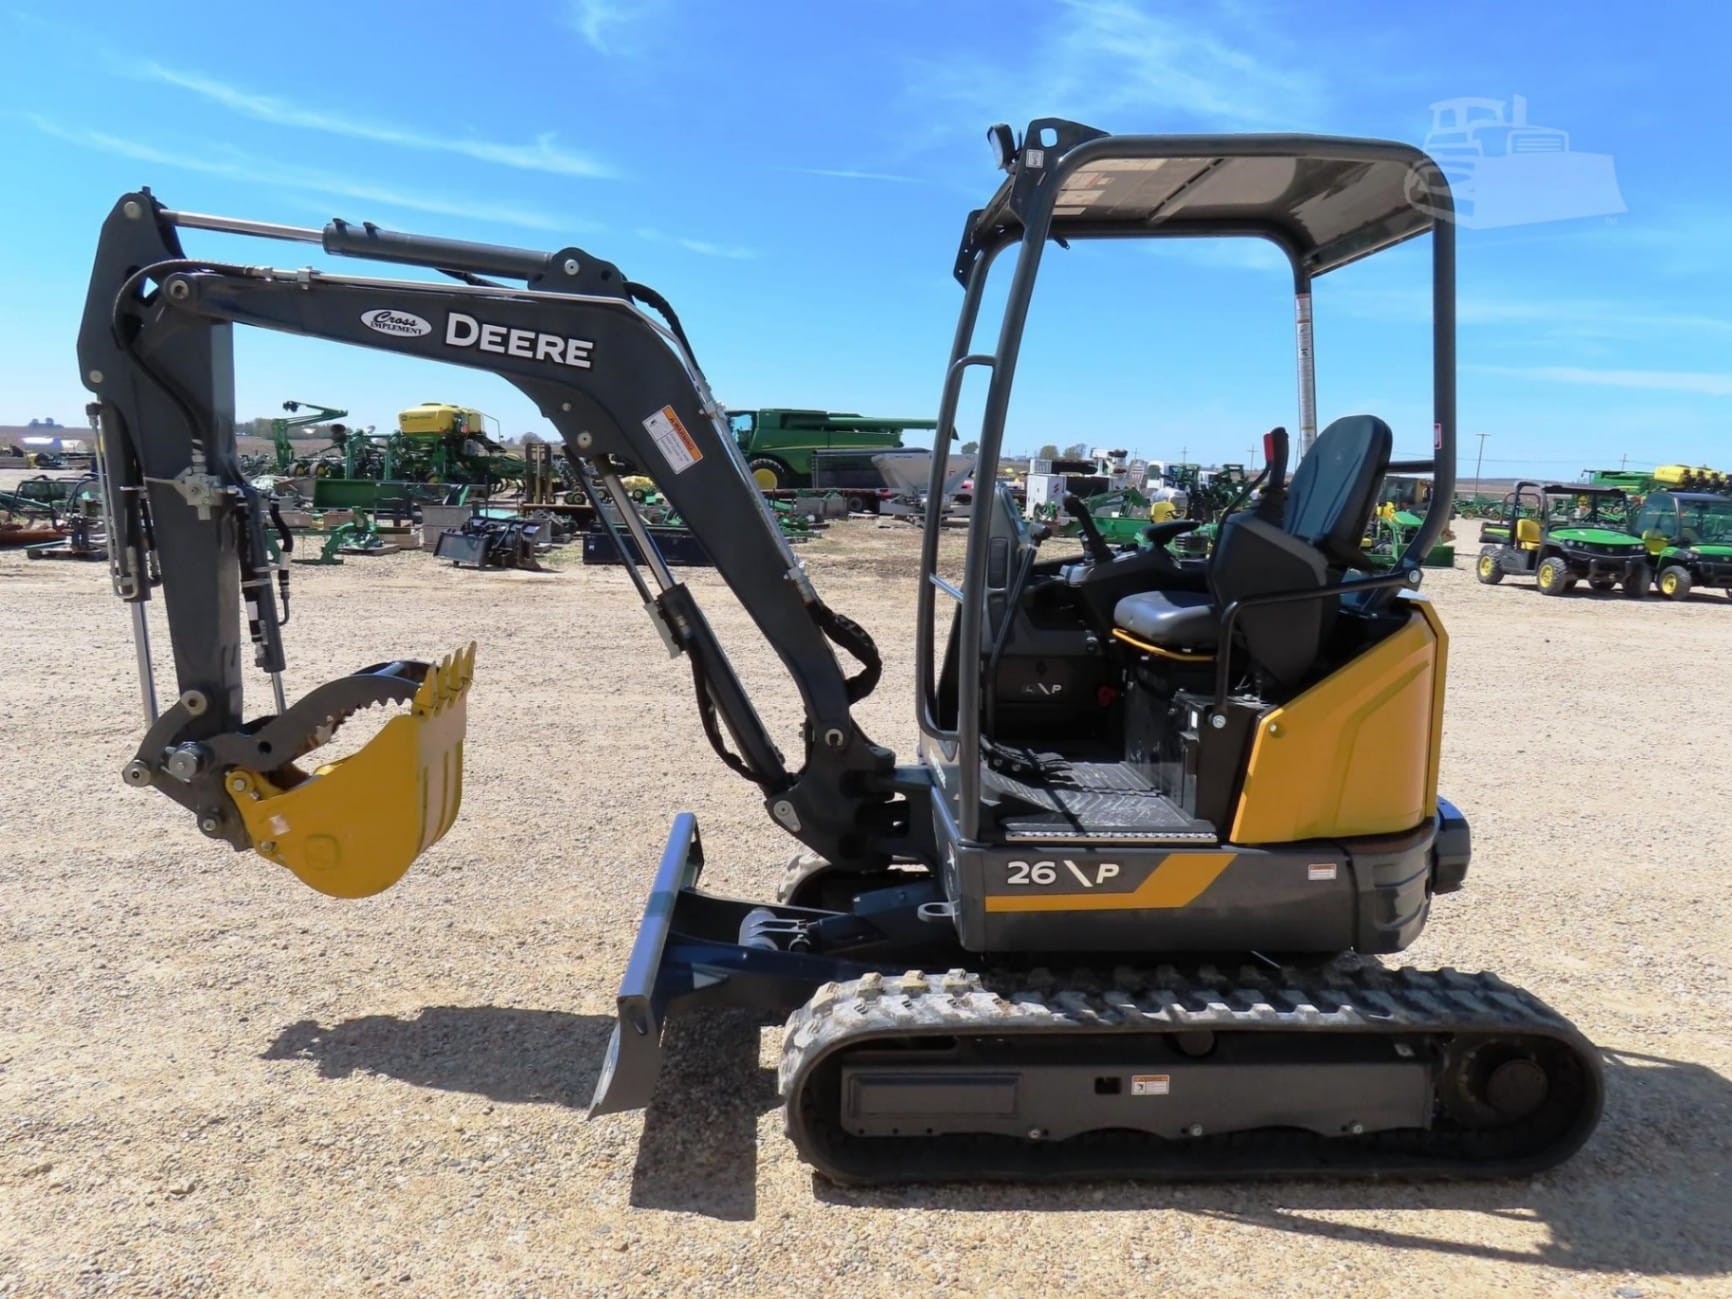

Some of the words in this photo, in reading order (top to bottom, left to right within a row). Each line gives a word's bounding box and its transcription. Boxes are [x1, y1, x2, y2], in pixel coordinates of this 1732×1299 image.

[370, 321, 422, 335] IMPLEMENT
[373, 311, 417, 327] Cross
[445, 312, 594, 369] DEERE
[1006, 860, 1057, 886] 26
